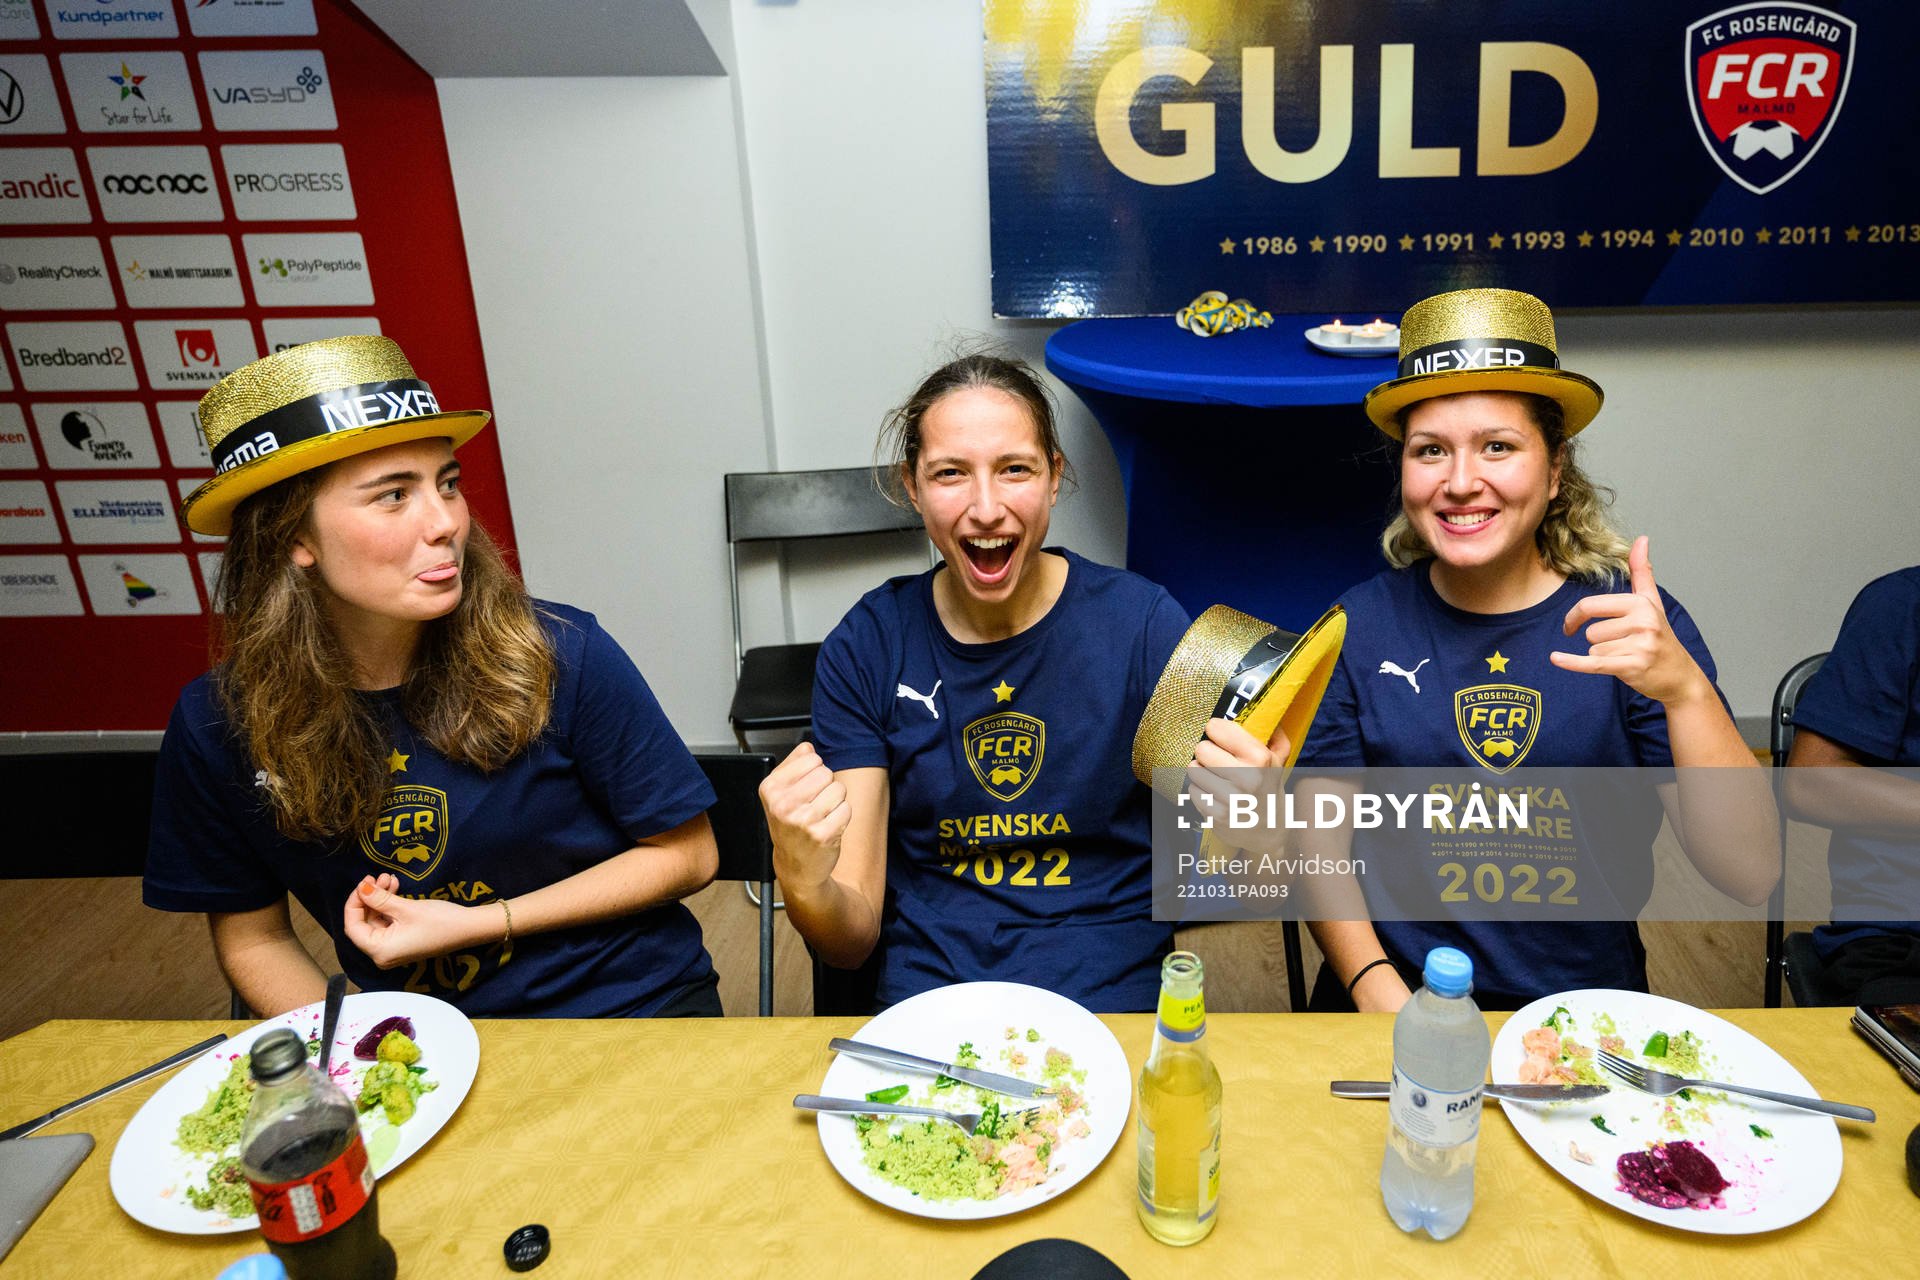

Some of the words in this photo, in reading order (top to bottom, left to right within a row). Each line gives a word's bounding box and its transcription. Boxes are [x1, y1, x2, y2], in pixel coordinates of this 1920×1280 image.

[58, 9, 164, 26] Kundpartner
[1702, 25, 1725, 45] FC
[1729, 15, 1841, 43] ROSENGÅRD
[1707, 53, 1829, 99] FCR
[1095, 41, 1599, 186] GULD
[0, 173, 80, 199] andic
[234, 173, 344, 193] PROGRESS
[1243, 236, 1298, 255] 1986
[1333, 235, 1387, 253] 1990
[1422, 233, 1474, 252] 1991
[1512, 231, 1566, 250] 1993
[1601, 229, 1655, 248] 1994
[1689, 227, 1744, 246] 2010
[1778, 226, 1831, 245] 2011
[1867, 224, 1920, 243] 2013
[18, 265, 103, 281] RealityCheck
[287, 258, 362, 273] PolyPeptide
[18, 346, 127, 367] Bredband2
[166, 371, 216, 381] SVENSKA
[72, 507, 165, 518] ELLENBOGEN
[1464, 693, 1476, 704] FC
[1477, 691, 1532, 704] ROSENGÅRD
[972, 726, 983, 736] FC
[984, 719, 1036, 734] ROSENGÅRD
[1469, 707, 1528, 729] FCR
[977, 736, 1033, 760] FCR
[991, 757, 1020, 765] MALMÖ
[383, 792, 437, 806] OSENGÅRD
[373, 810, 436, 843] FCR
[939, 813, 1072, 838] SVENSKA
[1437, 862, 1579, 905] 2022
